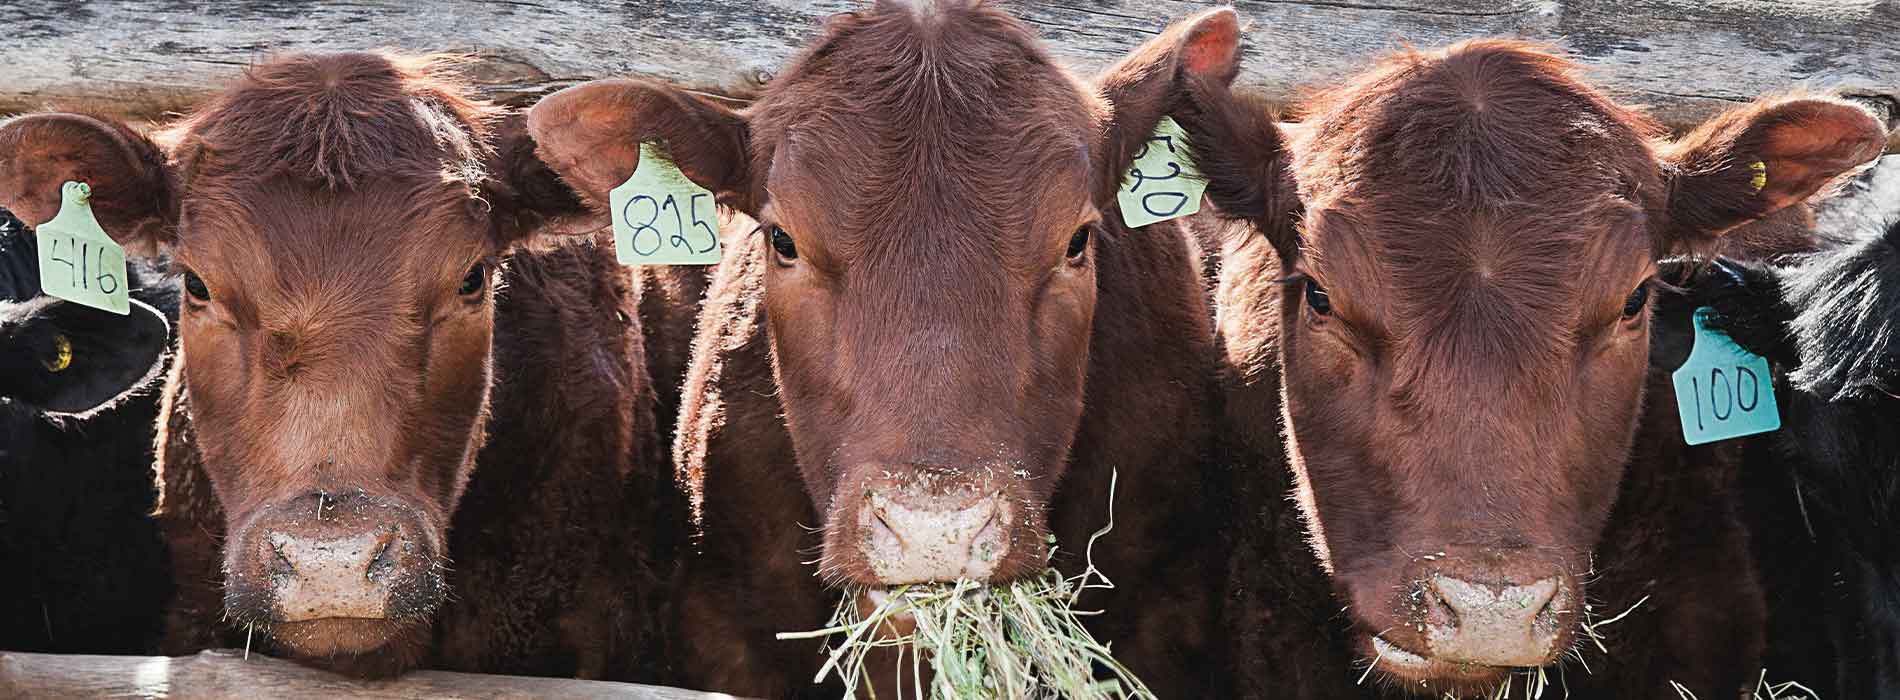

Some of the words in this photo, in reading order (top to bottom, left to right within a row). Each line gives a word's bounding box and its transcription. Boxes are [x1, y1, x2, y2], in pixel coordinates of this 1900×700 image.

[623, 194, 716, 256] 825
[51, 238, 118, 294] 416
[1692, 366, 1758, 431] 100
